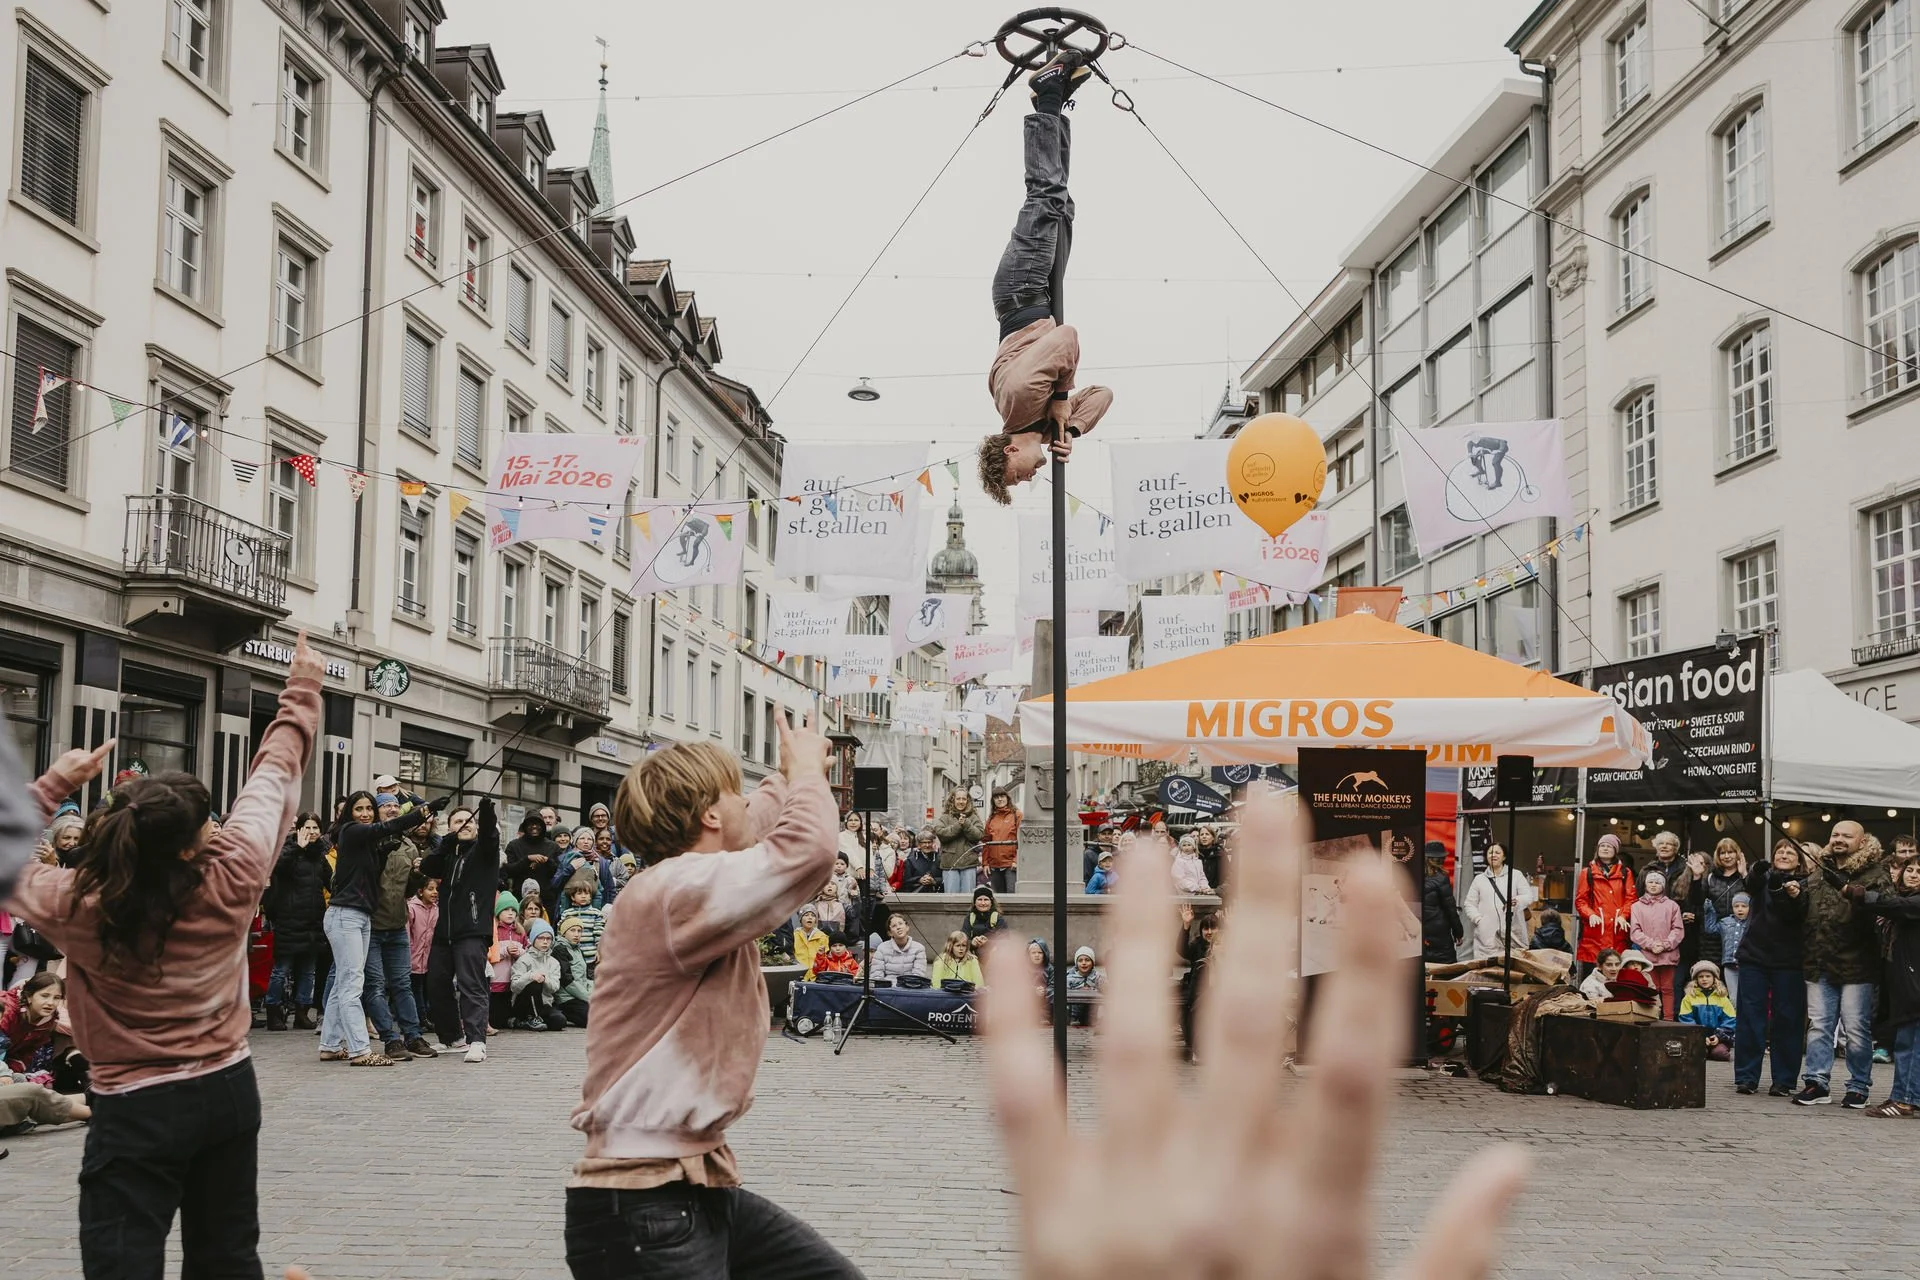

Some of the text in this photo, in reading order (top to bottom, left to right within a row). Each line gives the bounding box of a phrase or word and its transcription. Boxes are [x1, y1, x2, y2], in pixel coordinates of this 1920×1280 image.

[500, 470, 613, 489] Mai 2026
[1139, 472, 1187, 492] auf-
[809, 493, 903, 516] gtisch
[1148, 486, 1234, 516] getisch
[1040, 537, 1075, 551] a-
[1047, 549, 1116, 569] gtischt
[1272, 546, 1320, 563] 2026
[1032, 565, 1107, 584] st.allen
[787, 617, 838, 628] getischt
[1158, 613, 1185, 625] auf-
[1164, 622, 1216, 638] getischt
[245, 639, 351, 679] STARBUC FFEE
[1079, 654, 1121, 668] getischt
[1598, 648, 1757, 709] asian food
[1845, 683, 1897, 711] CE
[1186, 699, 1395, 739] MIGROS
[1642, 721, 1656, 731] RRY
[1690, 711, 1745, 727] SWEET & SOUR
[1690, 725, 1725, 738] CHICKEN
[1731, 742, 1750, 754] RIND
[1593, 771, 1643, 783] SATAY CHICKEN
[1687, 762, 1757, 777] HONG KONG ENTE
[1313, 793, 1412, 804] THE FUNKY MONKEYS
[1021, 829, 1080, 838] VADIVS
[928, 1011, 978, 1023] PROTENT
